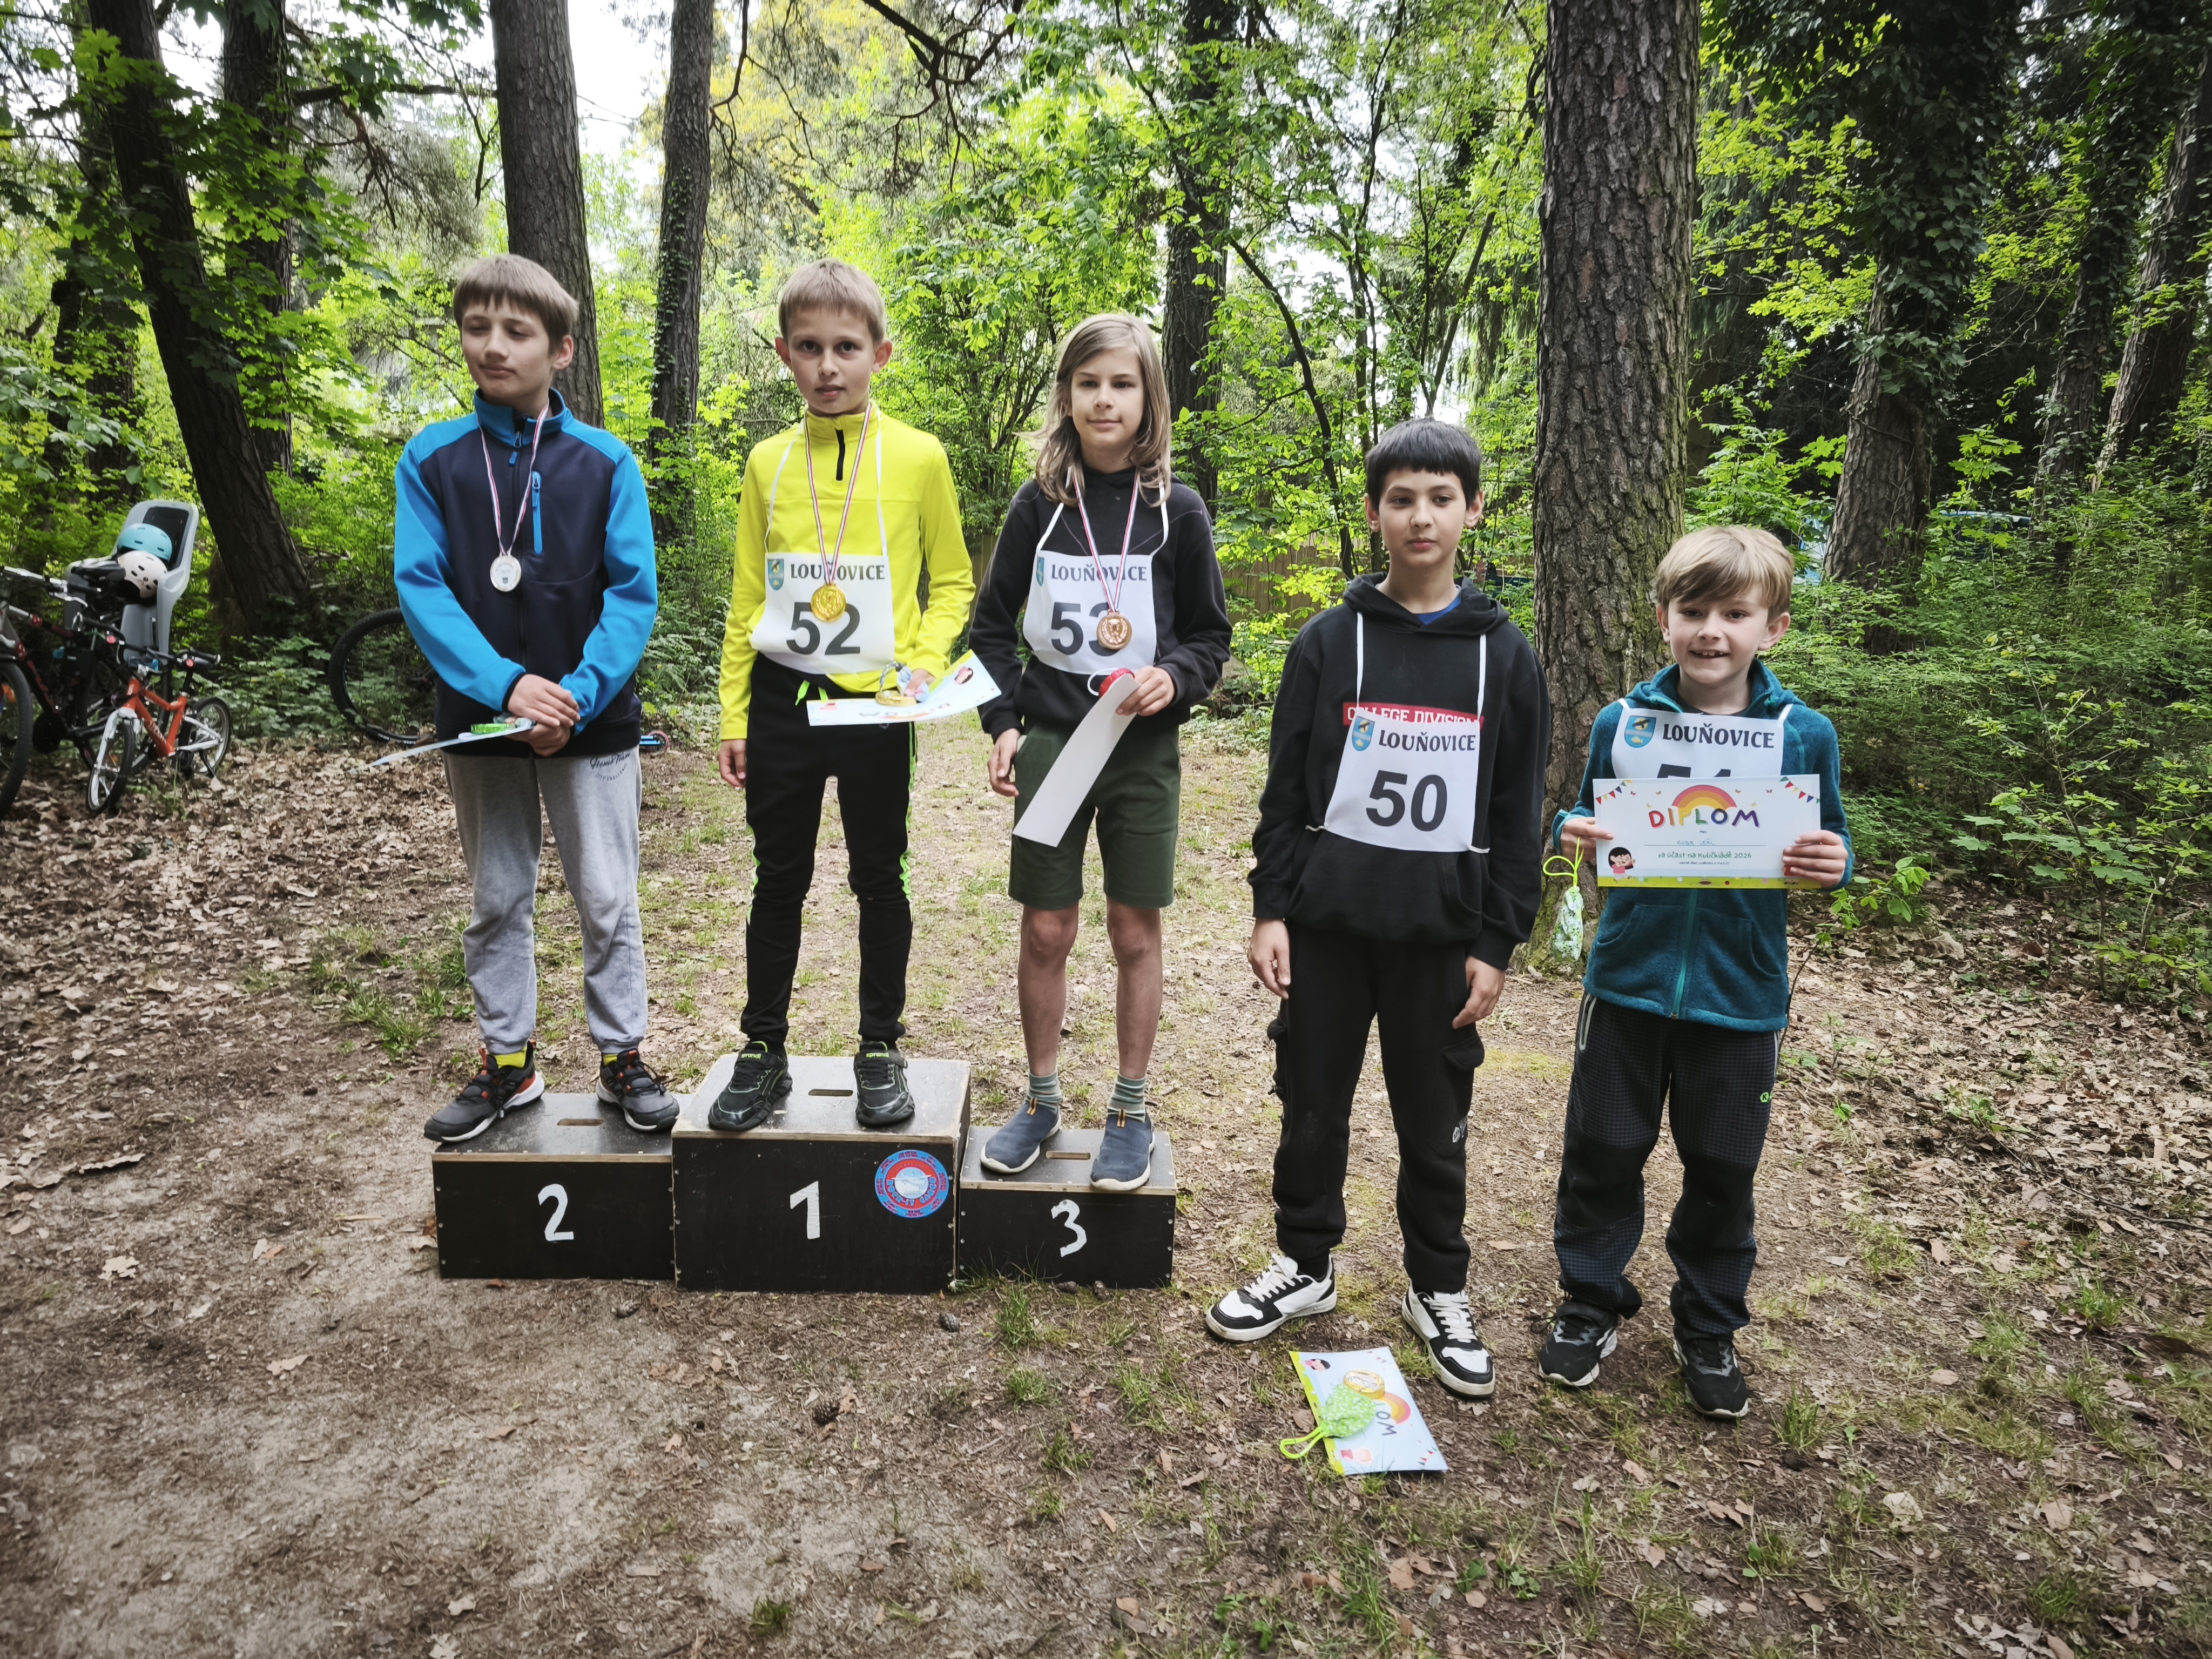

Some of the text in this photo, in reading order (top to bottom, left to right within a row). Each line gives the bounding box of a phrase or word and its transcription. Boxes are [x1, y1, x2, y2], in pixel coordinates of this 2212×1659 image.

[786, 602, 860, 656] 52
[1378, 730, 1476, 752] LOUŇOVICE
[1662, 723, 1775, 748] LOUŇOVICE
[1366, 770, 1447, 832] 50
[1649, 808, 1760, 828] DIPLOM
[537, 1184, 574, 1242] 2
[790, 1181, 820, 1239] 1
[1051, 1199, 1088, 1258] 3
